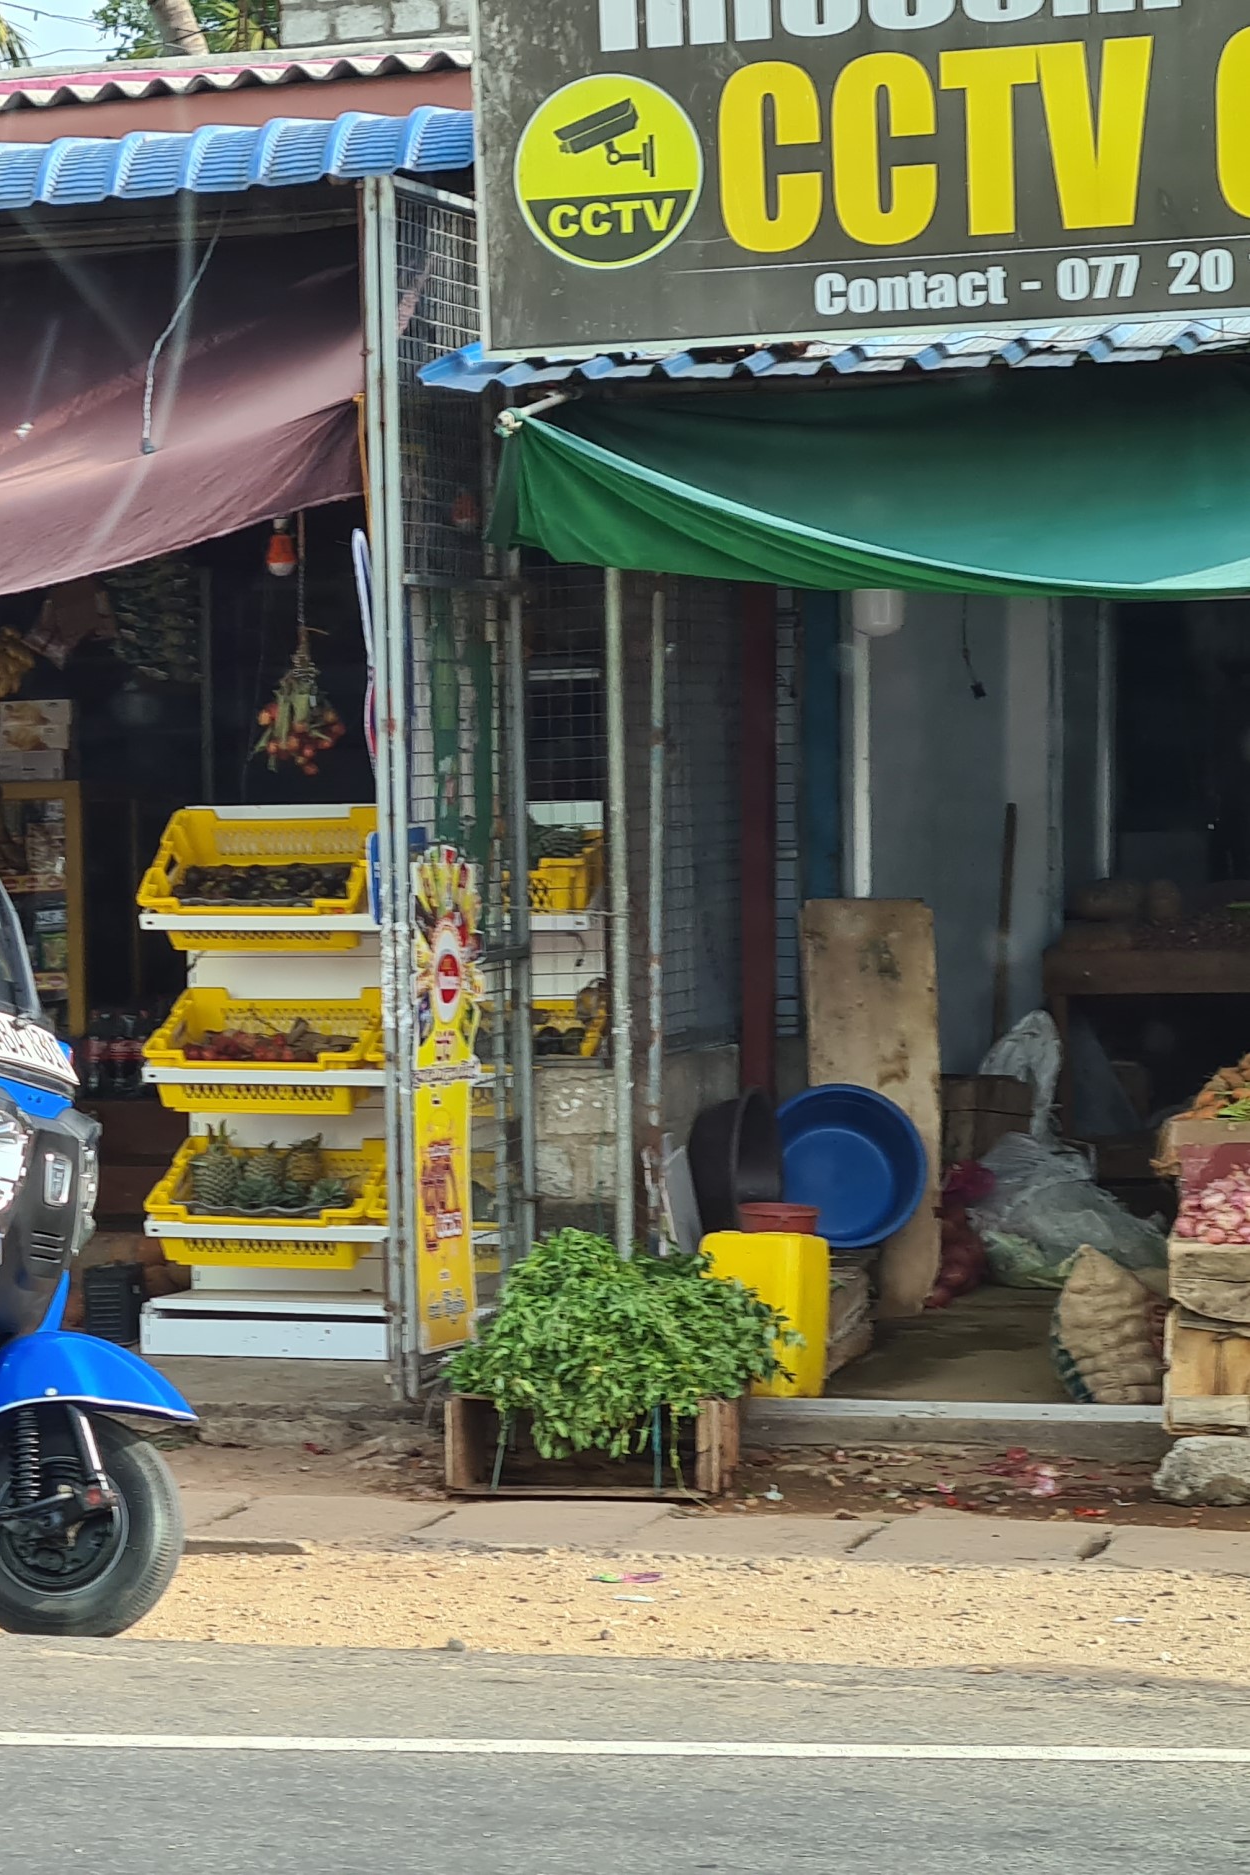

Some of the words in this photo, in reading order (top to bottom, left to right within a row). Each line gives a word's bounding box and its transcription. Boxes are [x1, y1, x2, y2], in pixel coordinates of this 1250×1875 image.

[718, 35, 1154, 253] CCTV
[547, 197, 676, 238] CCTV
[814, 266, 1009, 315] Contact
[1057, 254, 1140, 301] 077
[1167, 248, 1234, 295] 20
